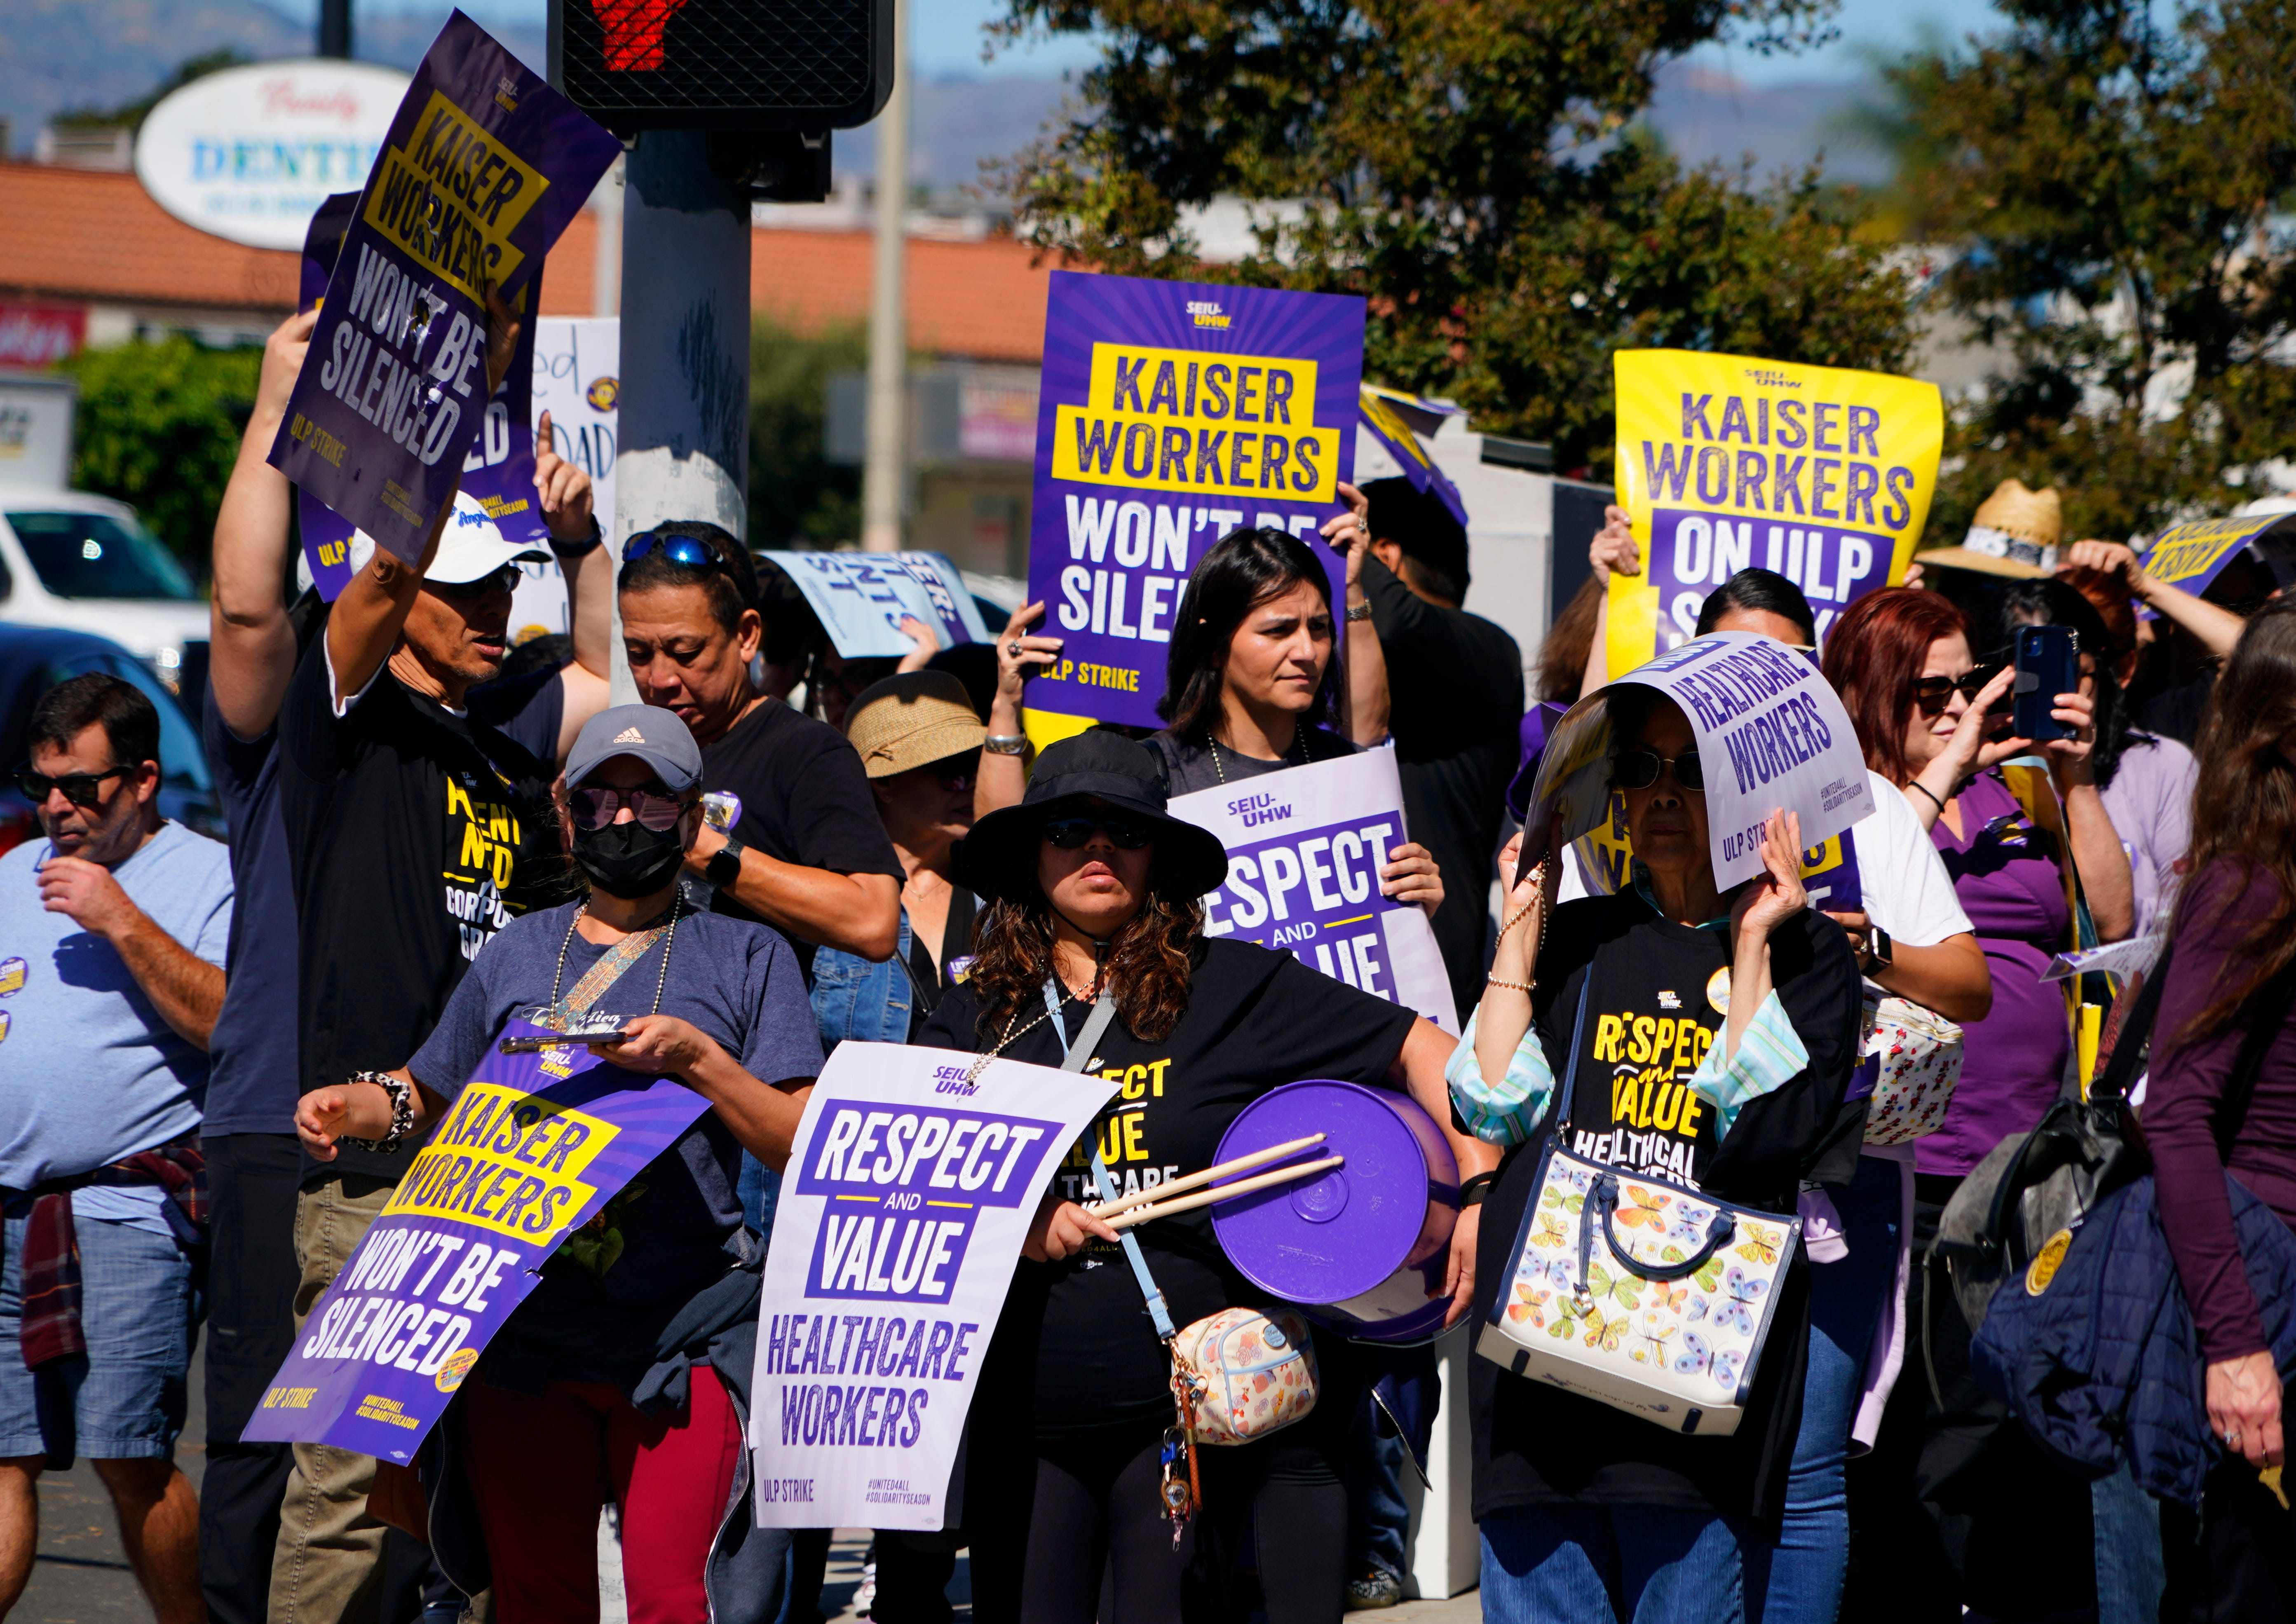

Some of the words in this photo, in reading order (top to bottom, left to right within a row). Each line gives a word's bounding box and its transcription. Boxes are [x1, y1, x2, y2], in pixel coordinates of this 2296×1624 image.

[415, 107, 524, 227] KAISER
[378, 160, 502, 301] WORKERS
[1186, 301, 1223, 315] SEIU-
[1194, 314, 1231, 328] UHW
[428, 310, 486, 398] BE
[321, 321, 460, 466] SILENCED
[1113, 356, 1294, 425] KAISER
[291, 413, 313, 442] ULP
[310, 428, 347, 468] STRIKE
[1682, 392, 1880, 458] KAISER
[1075, 417, 1320, 493] WORKERS
[1642, 440, 1915, 531] WORKERS
[318, 540, 346, 567] ULP
[1672, 516, 1753, 586] ON
[1059, 565, 1189, 642] SILE
[1078, 662, 1140, 692] STRIKE
[1670, 640, 1811, 733] HEALTHCARE
[1724, 691, 1832, 795] WORKERS
[1227, 793, 1276, 816] SEIU-
[1242, 804, 1292, 827] UHW
[1820, 781, 1848, 801] #UNITED4ALL
[1823, 783, 1863, 813] #SOLIDARITYSEASON
[1723, 832, 1744, 862] ULP
[1201, 823, 1393, 939] ESPECT
[1273, 921, 1317, 947] AND
[541, 1050, 571, 1065] SEIU-
[1593, 1011, 1719, 1070] RESPEC
[540, 1060, 573, 1078] UHW
[932, 1066, 969, 1081] SEIU
[935, 1080, 981, 1097] UHW
[1638, 1060, 1675, 1084] and
[441, 1091, 591, 1174] KAISER
[1611, 1074, 1704, 1139] VALUE
[814, 1109, 1044, 1193] RESPECT
[1573, 1128, 1695, 1180] HEALTHCA
[390, 1154, 572, 1235] WORKERS
[883, 1192, 922, 1212] AND
[343, 1228, 465, 1299] WON'T
[438, 1243, 520, 1313] BE
[820, 1216, 962, 1296] VALUE
[302, 1298, 472, 1377] SILENCED
[767, 1314, 979, 1382] HEALTHCARE
[263, 1387, 286, 1408] ULP
[280, 1387, 318, 1408] STRIKE
[355, 1404, 420, 1431] #SOLIDARITYSEASON
[362, 1394, 405, 1413] #UNITED4ALL
[781, 1385, 928, 1448] WORKERS
[764, 1479, 779, 1503] ULP
[782, 1479, 814, 1502] STRIKE
[865, 1492, 931, 1506] #SOLIDARITYSEASON
[868, 1479, 910, 1491] #UNITED4ALL
